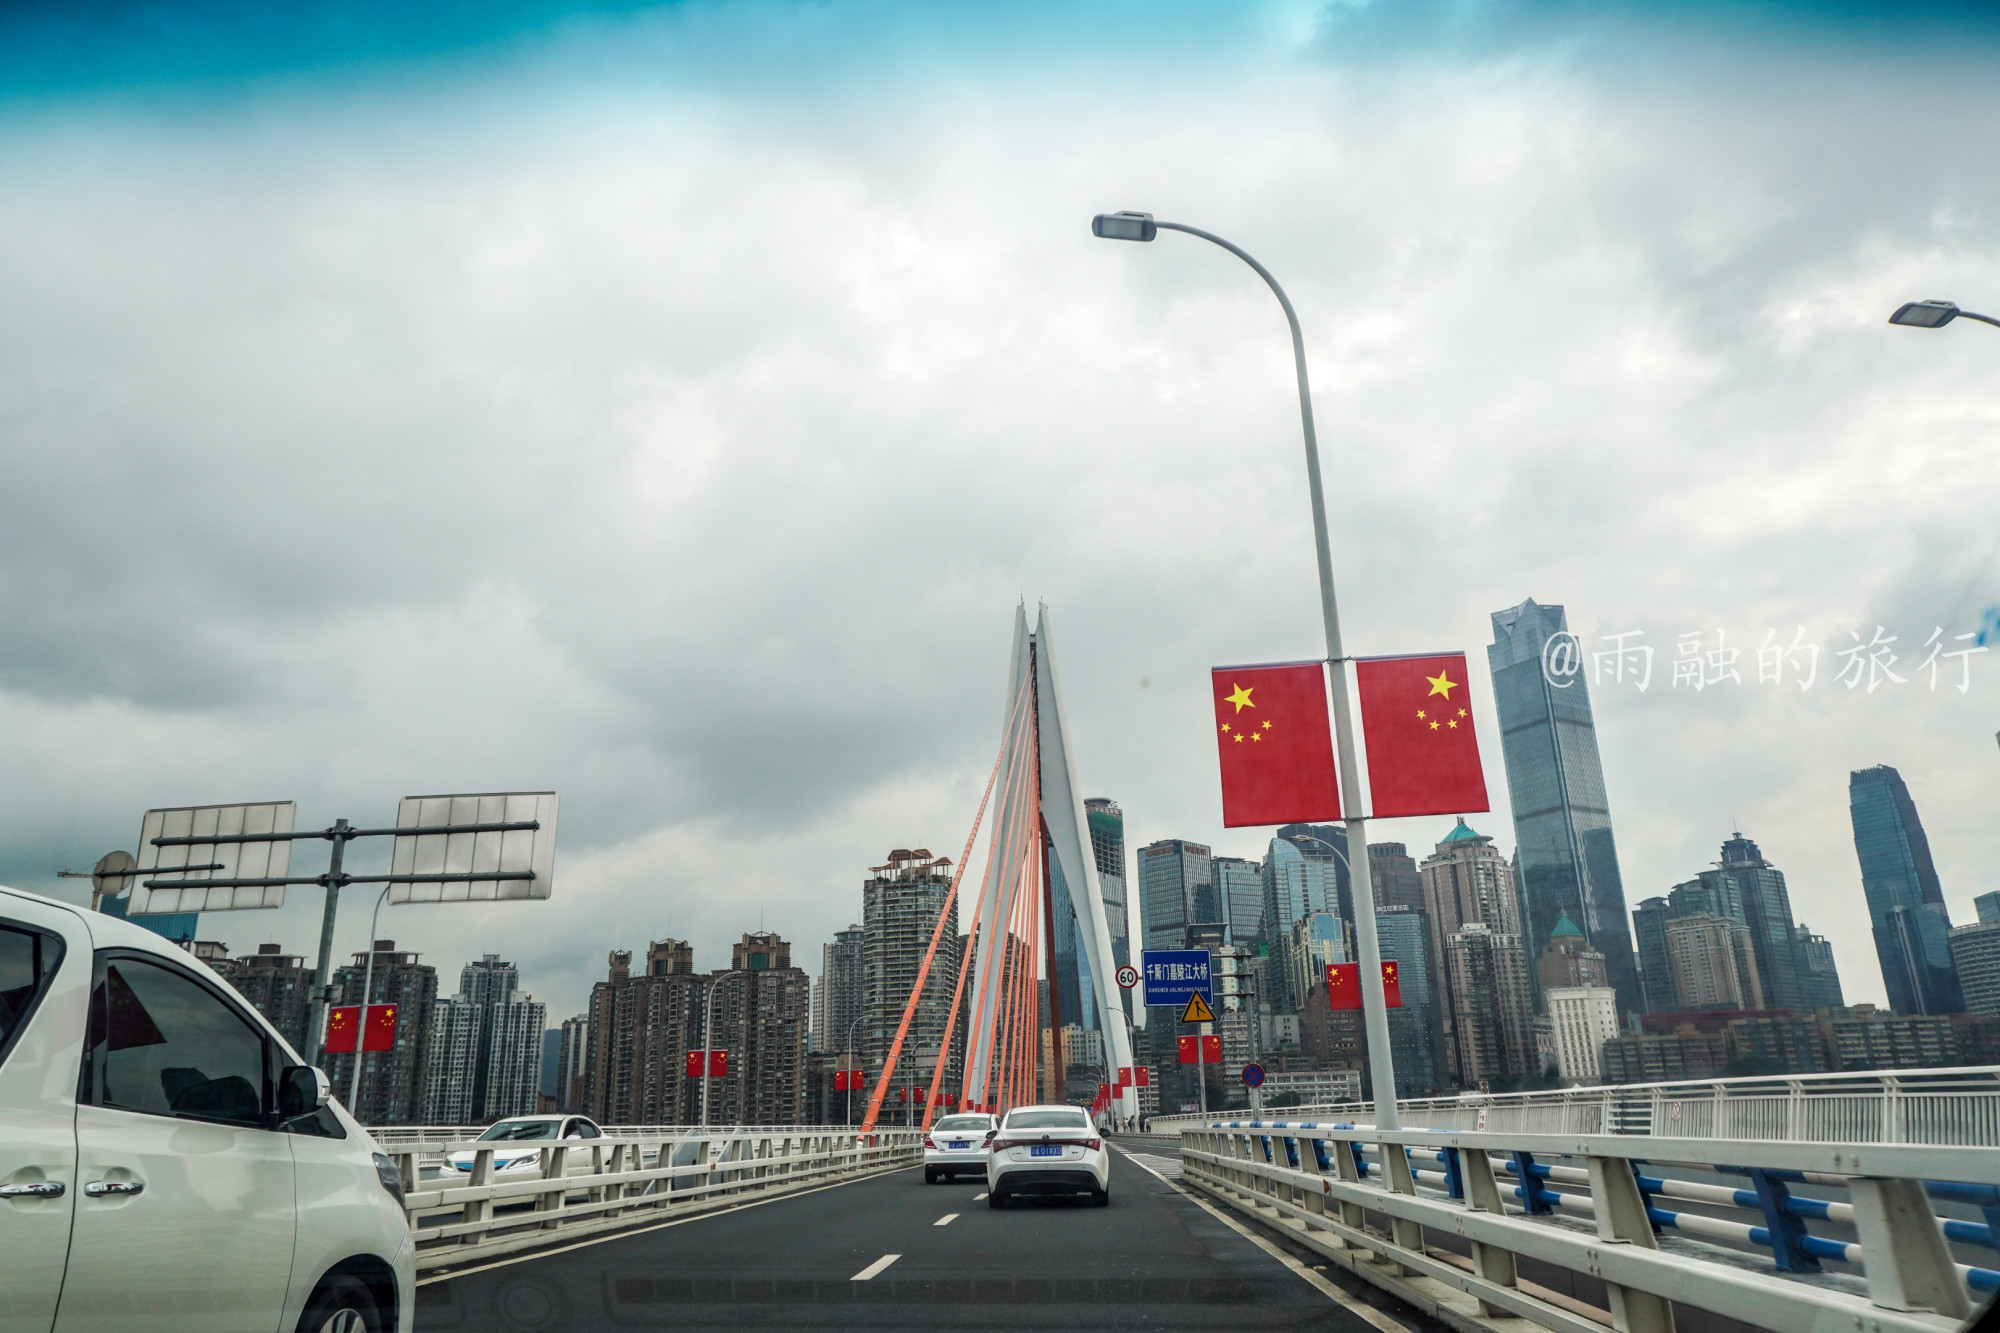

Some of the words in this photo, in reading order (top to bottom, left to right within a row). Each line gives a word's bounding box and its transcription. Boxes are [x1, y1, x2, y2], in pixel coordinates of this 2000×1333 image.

[1120, 971, 1134, 983] 60
[1146, 962, 1208, 981] 千厮门嘉陵江大桥
